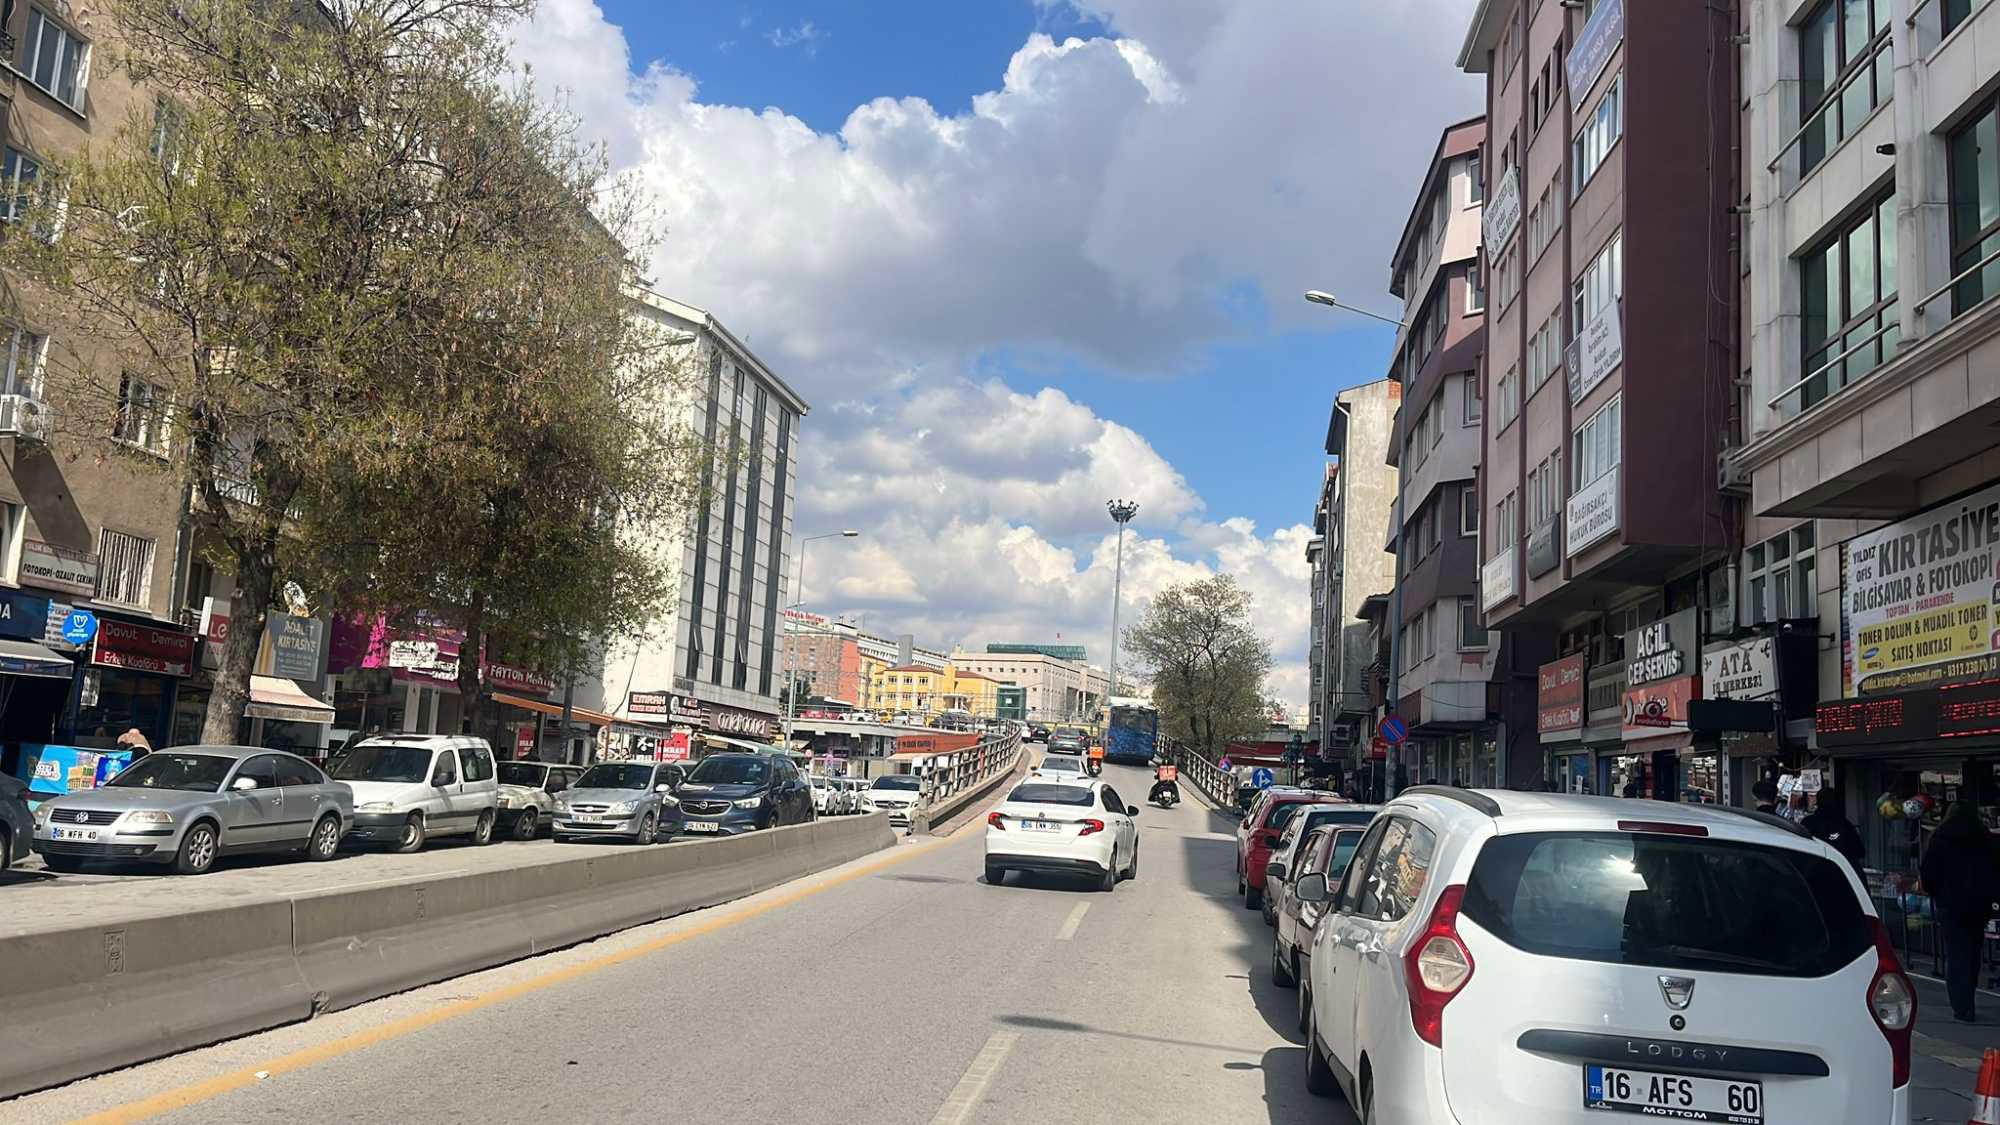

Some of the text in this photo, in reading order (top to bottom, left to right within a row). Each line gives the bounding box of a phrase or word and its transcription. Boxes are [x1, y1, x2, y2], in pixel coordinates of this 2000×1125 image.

[1569, 523, 1589, 546] HUKUK
[1878, 502, 2000, 578] KIRTASİYE
[1852, 545, 1876, 565] YILDIZ
[1852, 546, 1992, 614] BİLGİSAYAR & FOTOKOPİ
[1856, 566, 1872, 582] OFİS
[105, 623, 138, 640] Davut
[1858, 604, 1987, 647] TONER DOLUM & MUADİL TONER
[103, 651, 126, 664] Erkek
[1891, 643, 1914, 663] SATIŞ
[1916, 636, 1952, 658] NOKTASI
[490, 664, 524, 682] FAYTON
[1627, 661, 1645, 686] CEP
[1719, 649, 1753, 678] ATA
[632, 693, 666, 706] EMRAH
[1626, 1041, 1728, 1062] LODGY
[1591, 1085, 1602, 1095] TR
[1605, 1071, 1758, 1113] 16 AFS 60
[1642, 1105, 1708, 1120] MOTTOM
